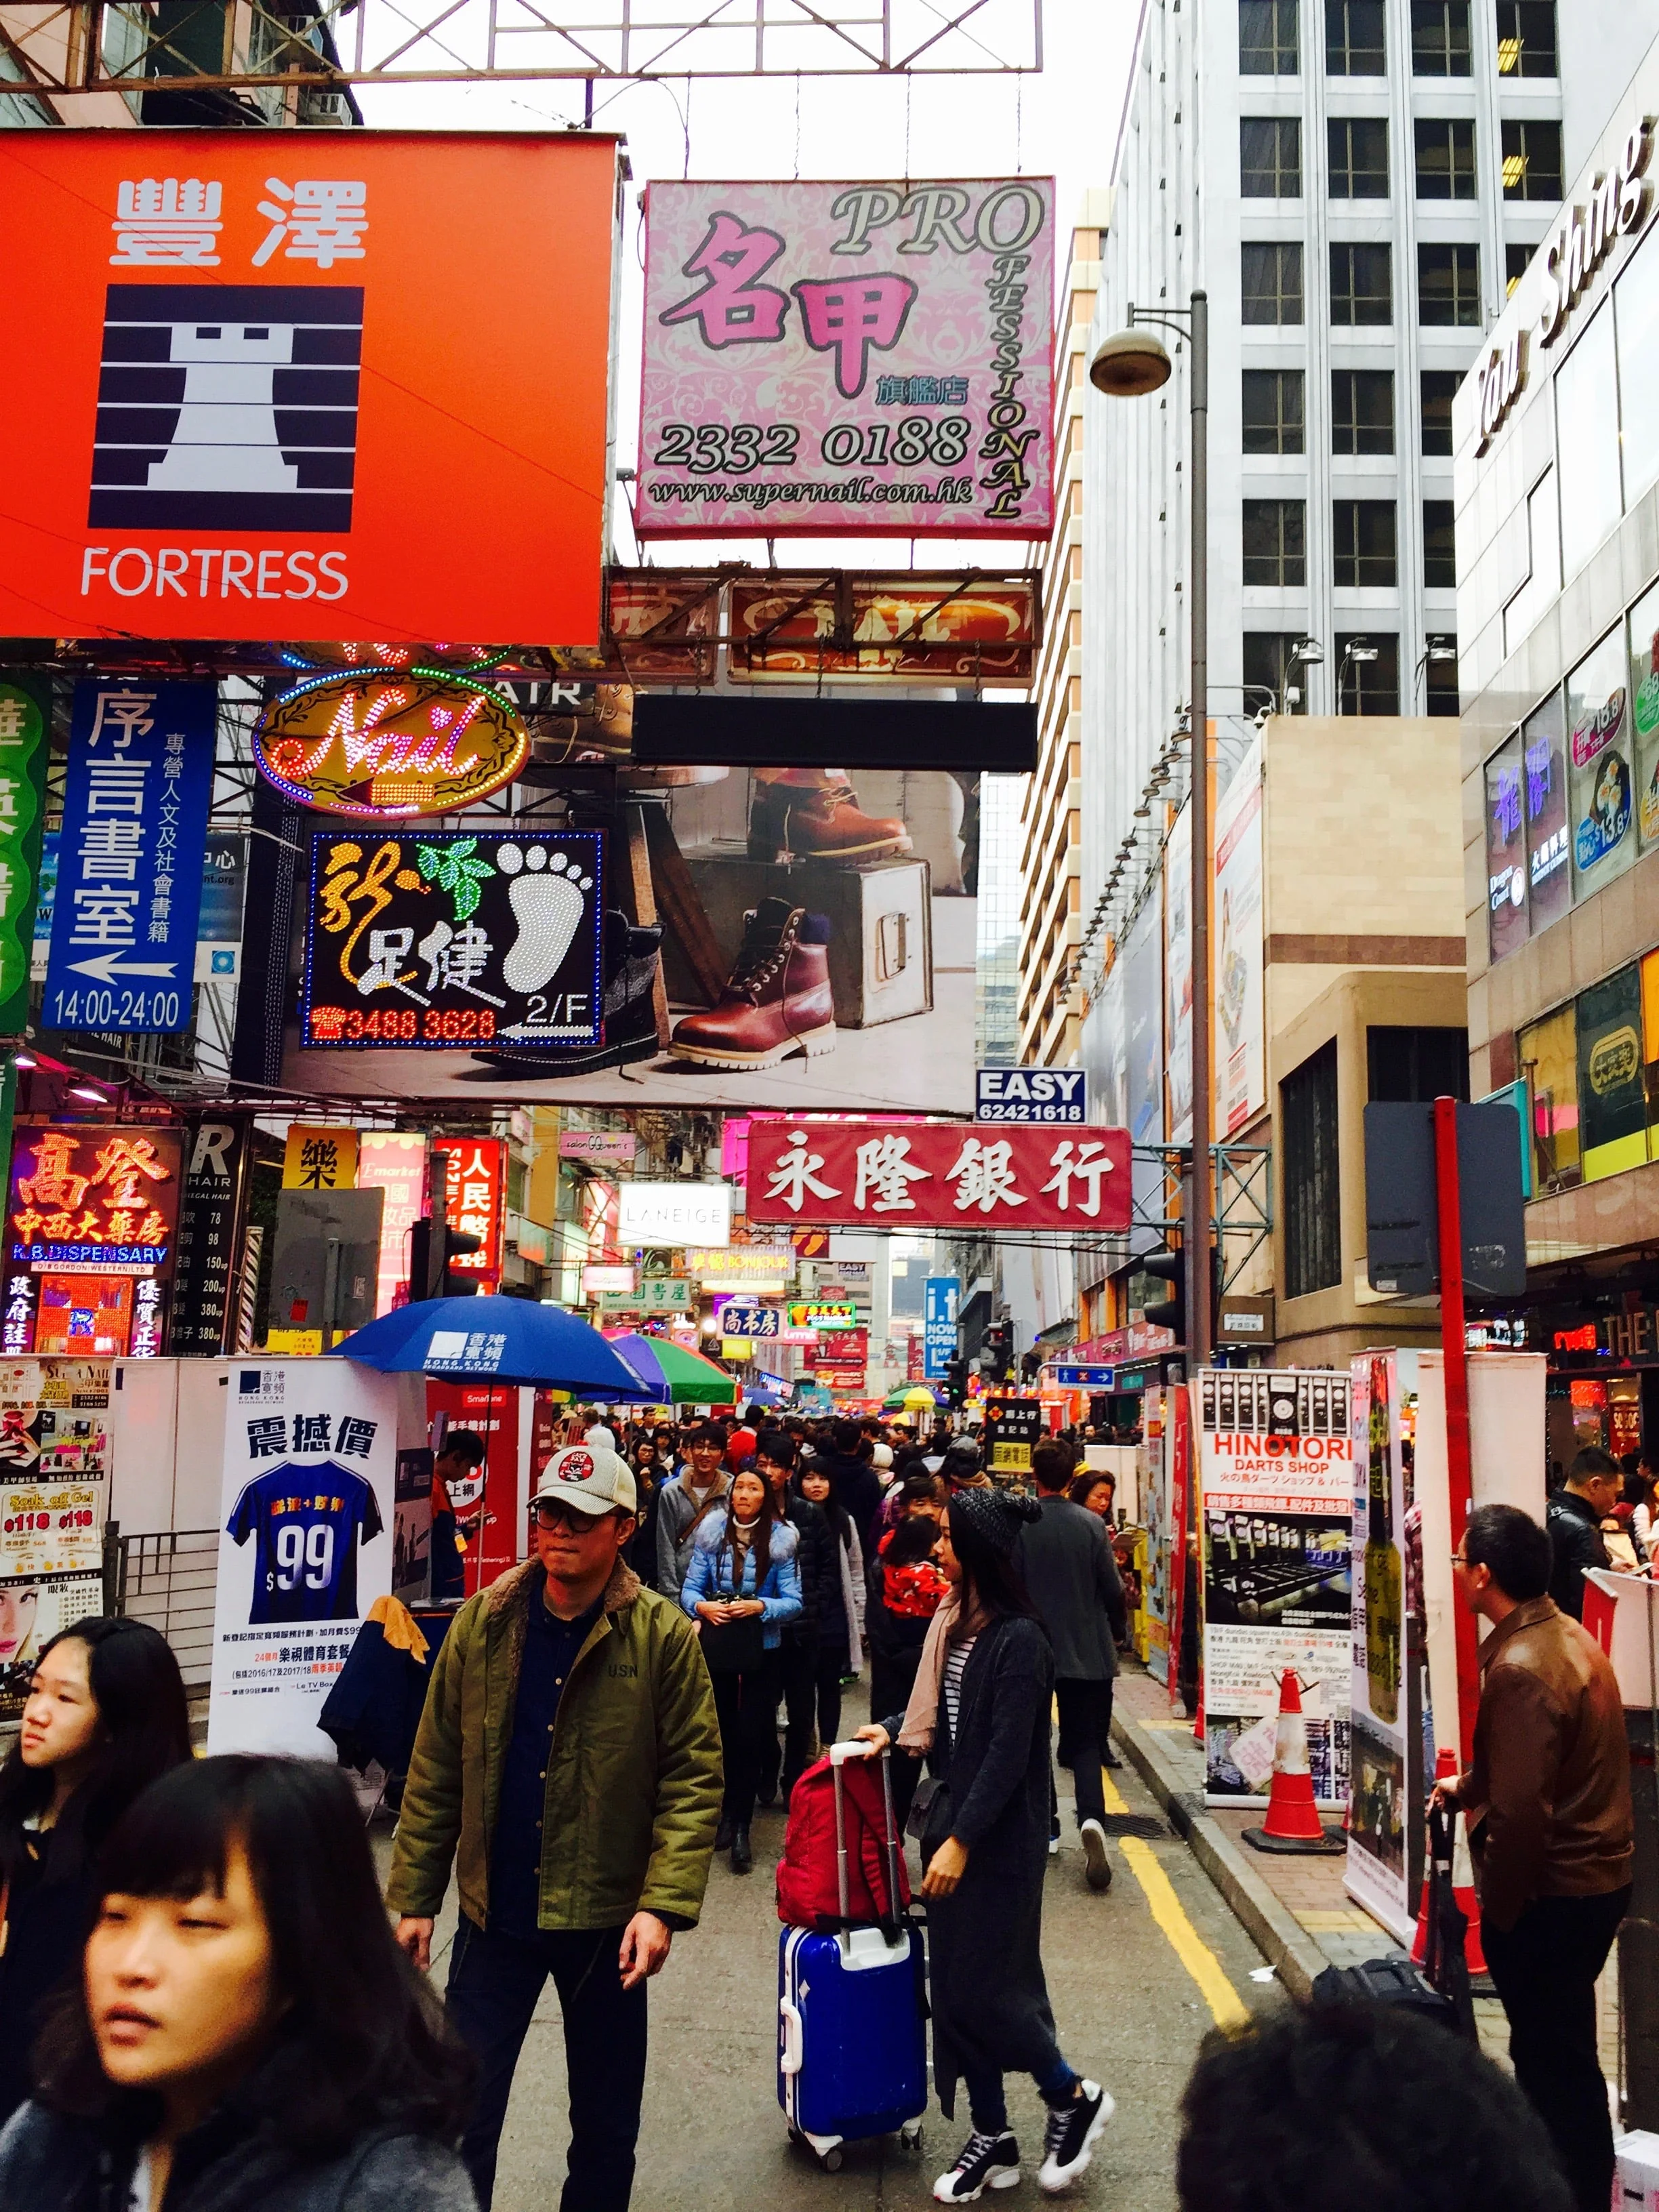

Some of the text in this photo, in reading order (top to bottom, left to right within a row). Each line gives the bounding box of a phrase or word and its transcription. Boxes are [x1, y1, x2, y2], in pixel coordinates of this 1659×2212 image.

[109, 178, 369, 268] 豐澤
[830, 185, 1045, 255] PRO
[1539, 115, 1658, 348] Shing
[659, 211, 918, 399] 名甲
[979, 254, 1040, 519] FESSIONAL
[655, 415, 972, 475] 2332 0188
[649, 476, 973, 509] www.supernail.com.hk
[81, 547, 350, 600] FORTRESS
[272, 688, 486, 777] Nail
[69, 688, 158, 946] 序言書室
[146, 733, 187, 943] 專營人文及社會書籍
[55, 989, 179, 1027] 14:00-24:00
[526, 993, 588, 1023] 2/F
[423, 1009, 495, 1040] 3628
[979, 1072, 1081, 1101] EASY
[979, 1103, 1082, 1122] 62421618
[188, 1124, 235, 1175] R
[18, 1132, 171, 1210] 高登
[188, 1176, 231, 1187] HAIR
[362, 1162, 422, 1179] Emarket
[763, 1128, 1114, 1218] 永隆銀行
[210, 1212, 222, 1225] 78
[626, 1207, 722, 1223] LANEIGE
[207, 1232, 219, 1246] 98
[727, 1254, 790, 1270] BONJOUR
[927, 1287, 958, 1322] i.t
[724, 1309, 778, 1336] 尚书房
[926, 1323, 957, 1335] NOW
[469, 1332, 508, 1347] 香港
[926, 1334, 957, 1346] OPEN
[262, 1370, 285, 1382] 香港
[247, 1413, 378, 1460] 震撼價
[1214, 1433, 1353, 1461] HINOTORI
[1235, 1458, 1330, 1474] DARTS SHOP
[9, 1491, 94, 1507] Soak off Gel
